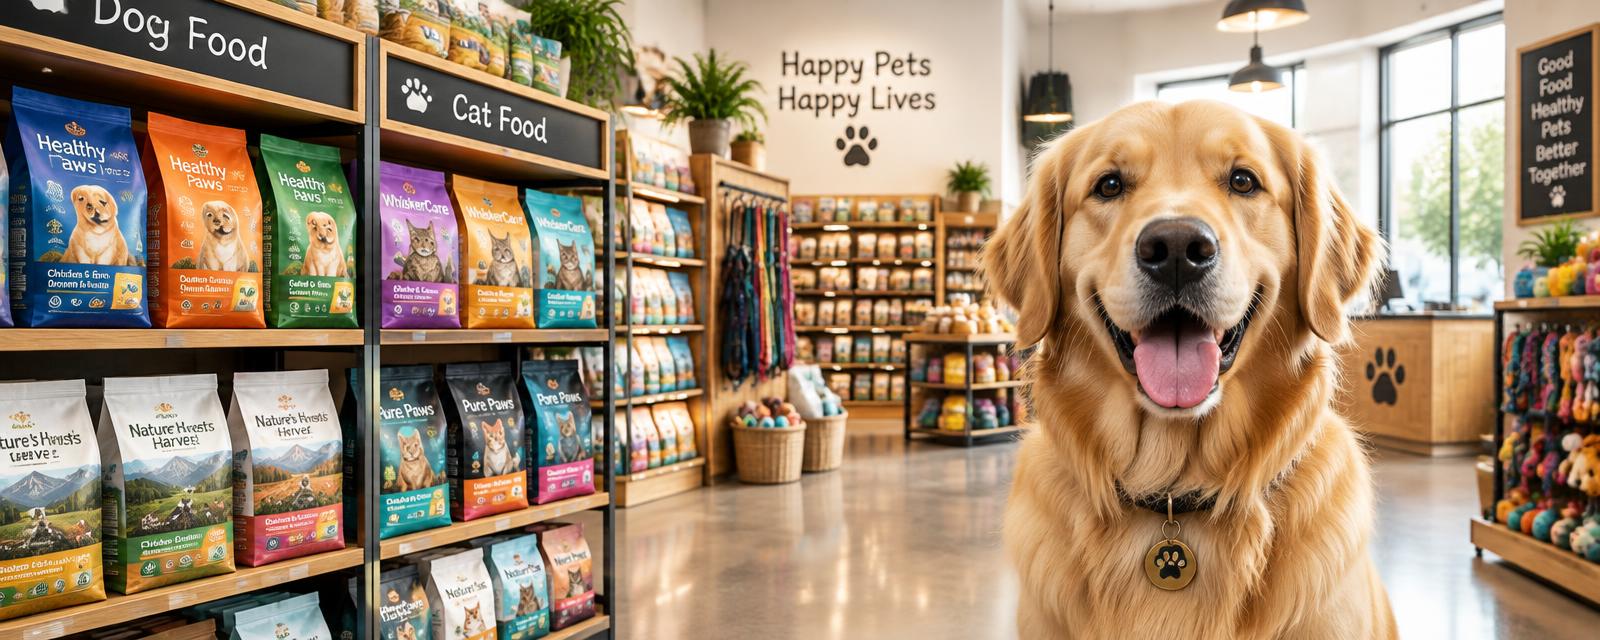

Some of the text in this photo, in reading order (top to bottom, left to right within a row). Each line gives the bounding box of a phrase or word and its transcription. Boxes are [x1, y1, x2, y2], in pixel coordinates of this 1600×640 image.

[94, 0, 268, 70] Dog Food
[781, 50, 931, 84] Happy Pets
[1537, 50, 1574, 75] Good
[1539, 73, 1573, 97] Food
[778, 86, 936, 118] Happy Lives
[1531, 95, 1584, 120] Healthy
[452, 93, 548, 144] Cat Food
[1541, 119, 1572, 139] Pets
[36, 133, 106, 163] Healthy
[1535, 141, 1579, 162] Better
[169, 155, 226, 179] Healthy
[1528, 161, 1586, 186] Together
[187, 174, 223, 192] Paws
[403, 403, 435, 417] Paws
[462, 397, 515, 412] Pure Paws
[255, 413, 298, 428] Nature's
